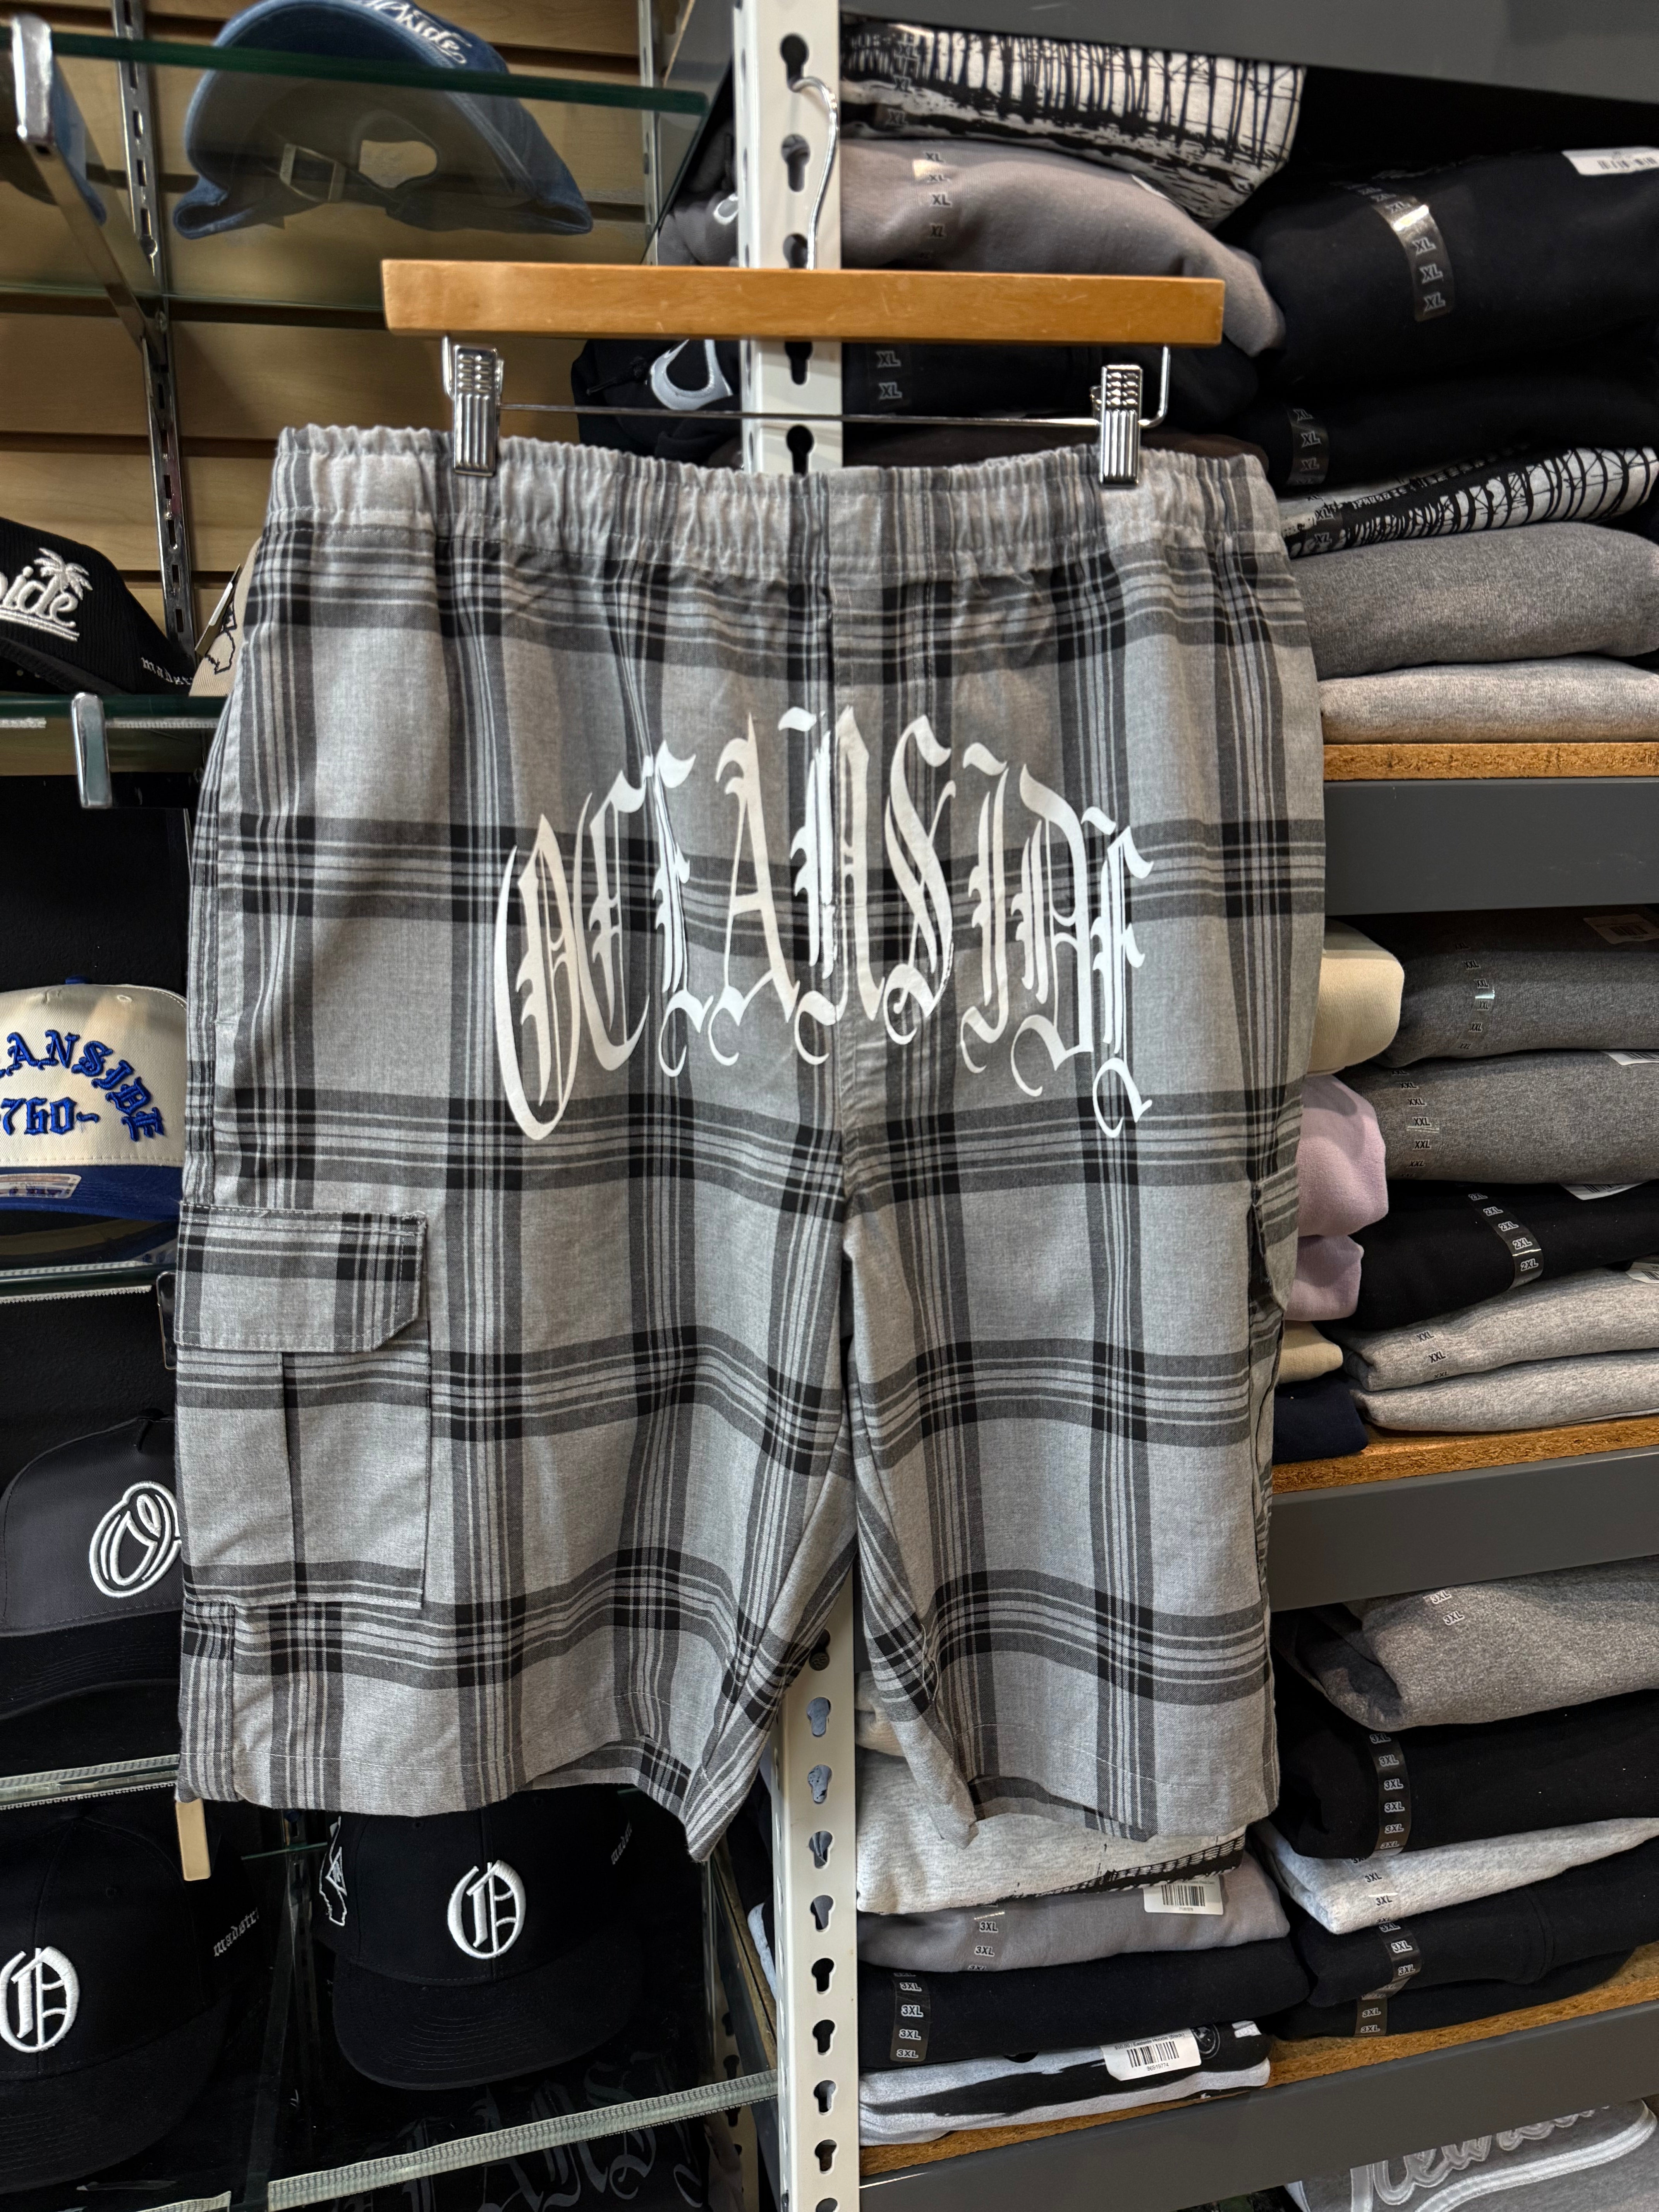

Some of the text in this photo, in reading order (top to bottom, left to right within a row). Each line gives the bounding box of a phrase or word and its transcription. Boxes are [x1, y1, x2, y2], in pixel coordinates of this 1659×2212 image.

[924, 152, 945, 163] XL
[928, 174, 948, 182] XL
[930, 192, 952, 207] XL
[1385, 201, 1411, 213] XL
[930, 224, 945, 238] XL
[1412, 236, 1437, 256] XL
[1419, 263, 1444, 284] XL
[1423, 292, 1446, 312] XL
[876, 350, 901, 368] XL
[878, 382, 903, 400] XL
[1293, 408, 1314, 421] XL
[1300, 431, 1321, 448] XL
[1300, 457, 1320, 471] XL
[1315, 506, 1334, 521] XL
[1314, 532, 1332, 545] XL
[495, 706, 1153, 1139] OCEANSIDE
[1463, 960, 1481, 969] XXL
[1475, 979, 1489, 988] XXL
[1478, 1001, 1489, 1010] XXL
[1470, 1023, 1482, 1032] XXL
[0, 1029, 165, 1142] ANSIDE
[1408, 1098, 1426, 1106] XXL
[1413, 1117, 1431, 1126] XXL
[1413, 1140, 1431, 1149] XXL
[1483, 1206, 1503, 1216] 2XL
[1498, 1221, 1519, 1231] 2XL
[1512, 1237, 1533, 1250] 2XL
[1520, 1259, 1539, 1271] 2XL
[1416, 1331, 1435, 1342] XXL
[1428, 1350, 1447, 1364] XXL
[1430, 1590, 1452, 1604] 3XL
[1443, 1611, 1465, 1625] 3XL
[1369, 1733, 1391, 1744] 3XL
[1379, 1754, 1399, 1767] 3XL
[1384, 1778, 1404, 1791] 3XL
[1384, 1802, 1405, 1813] 3XL
[1384, 1824, 1404, 1834] 3XL
[1380, 1841, 1400, 1849] 3XL
[1365, 1873, 1382, 1882] 3XL
[1376, 1895, 1393, 1906] 3XL
[979, 1921, 998, 1933] 3XL
[1379, 1922, 1401, 1932] 3XL
[974, 1946, 994, 1957] 3XL
[1391, 1940, 1413, 1953] 3XL
[1398, 1964, 1415, 1976] 3XL
[900, 1982, 922, 1992] 3XL
[901, 2005, 924, 2017] 3XL
[1362, 2008, 1381, 2018] 3XL
[899, 2029, 921, 2040] 3XL
[1360, 2025, 1380, 2033] 3XL
[896, 2049, 919, 2058] 3XL
